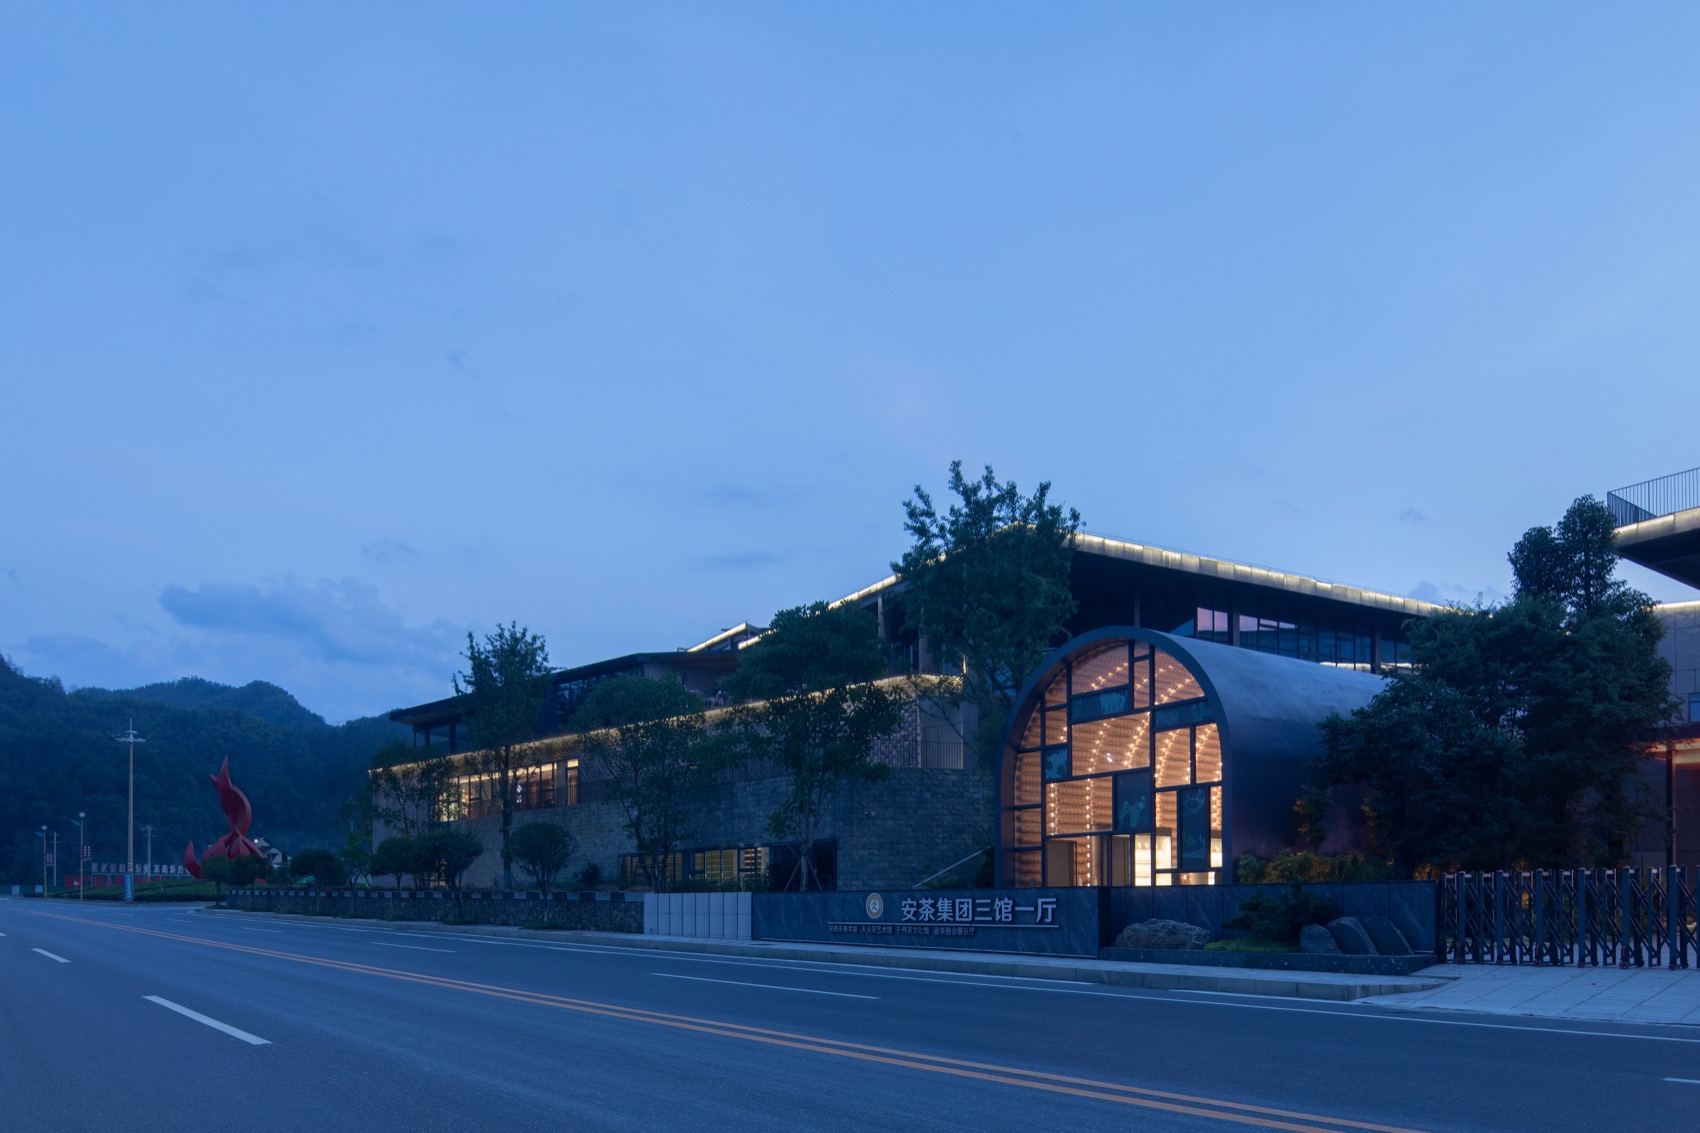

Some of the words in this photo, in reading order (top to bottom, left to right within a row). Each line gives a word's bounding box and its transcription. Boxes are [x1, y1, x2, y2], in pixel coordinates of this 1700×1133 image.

[901, 898, 1057, 923] 安茶集团三馆一厅
